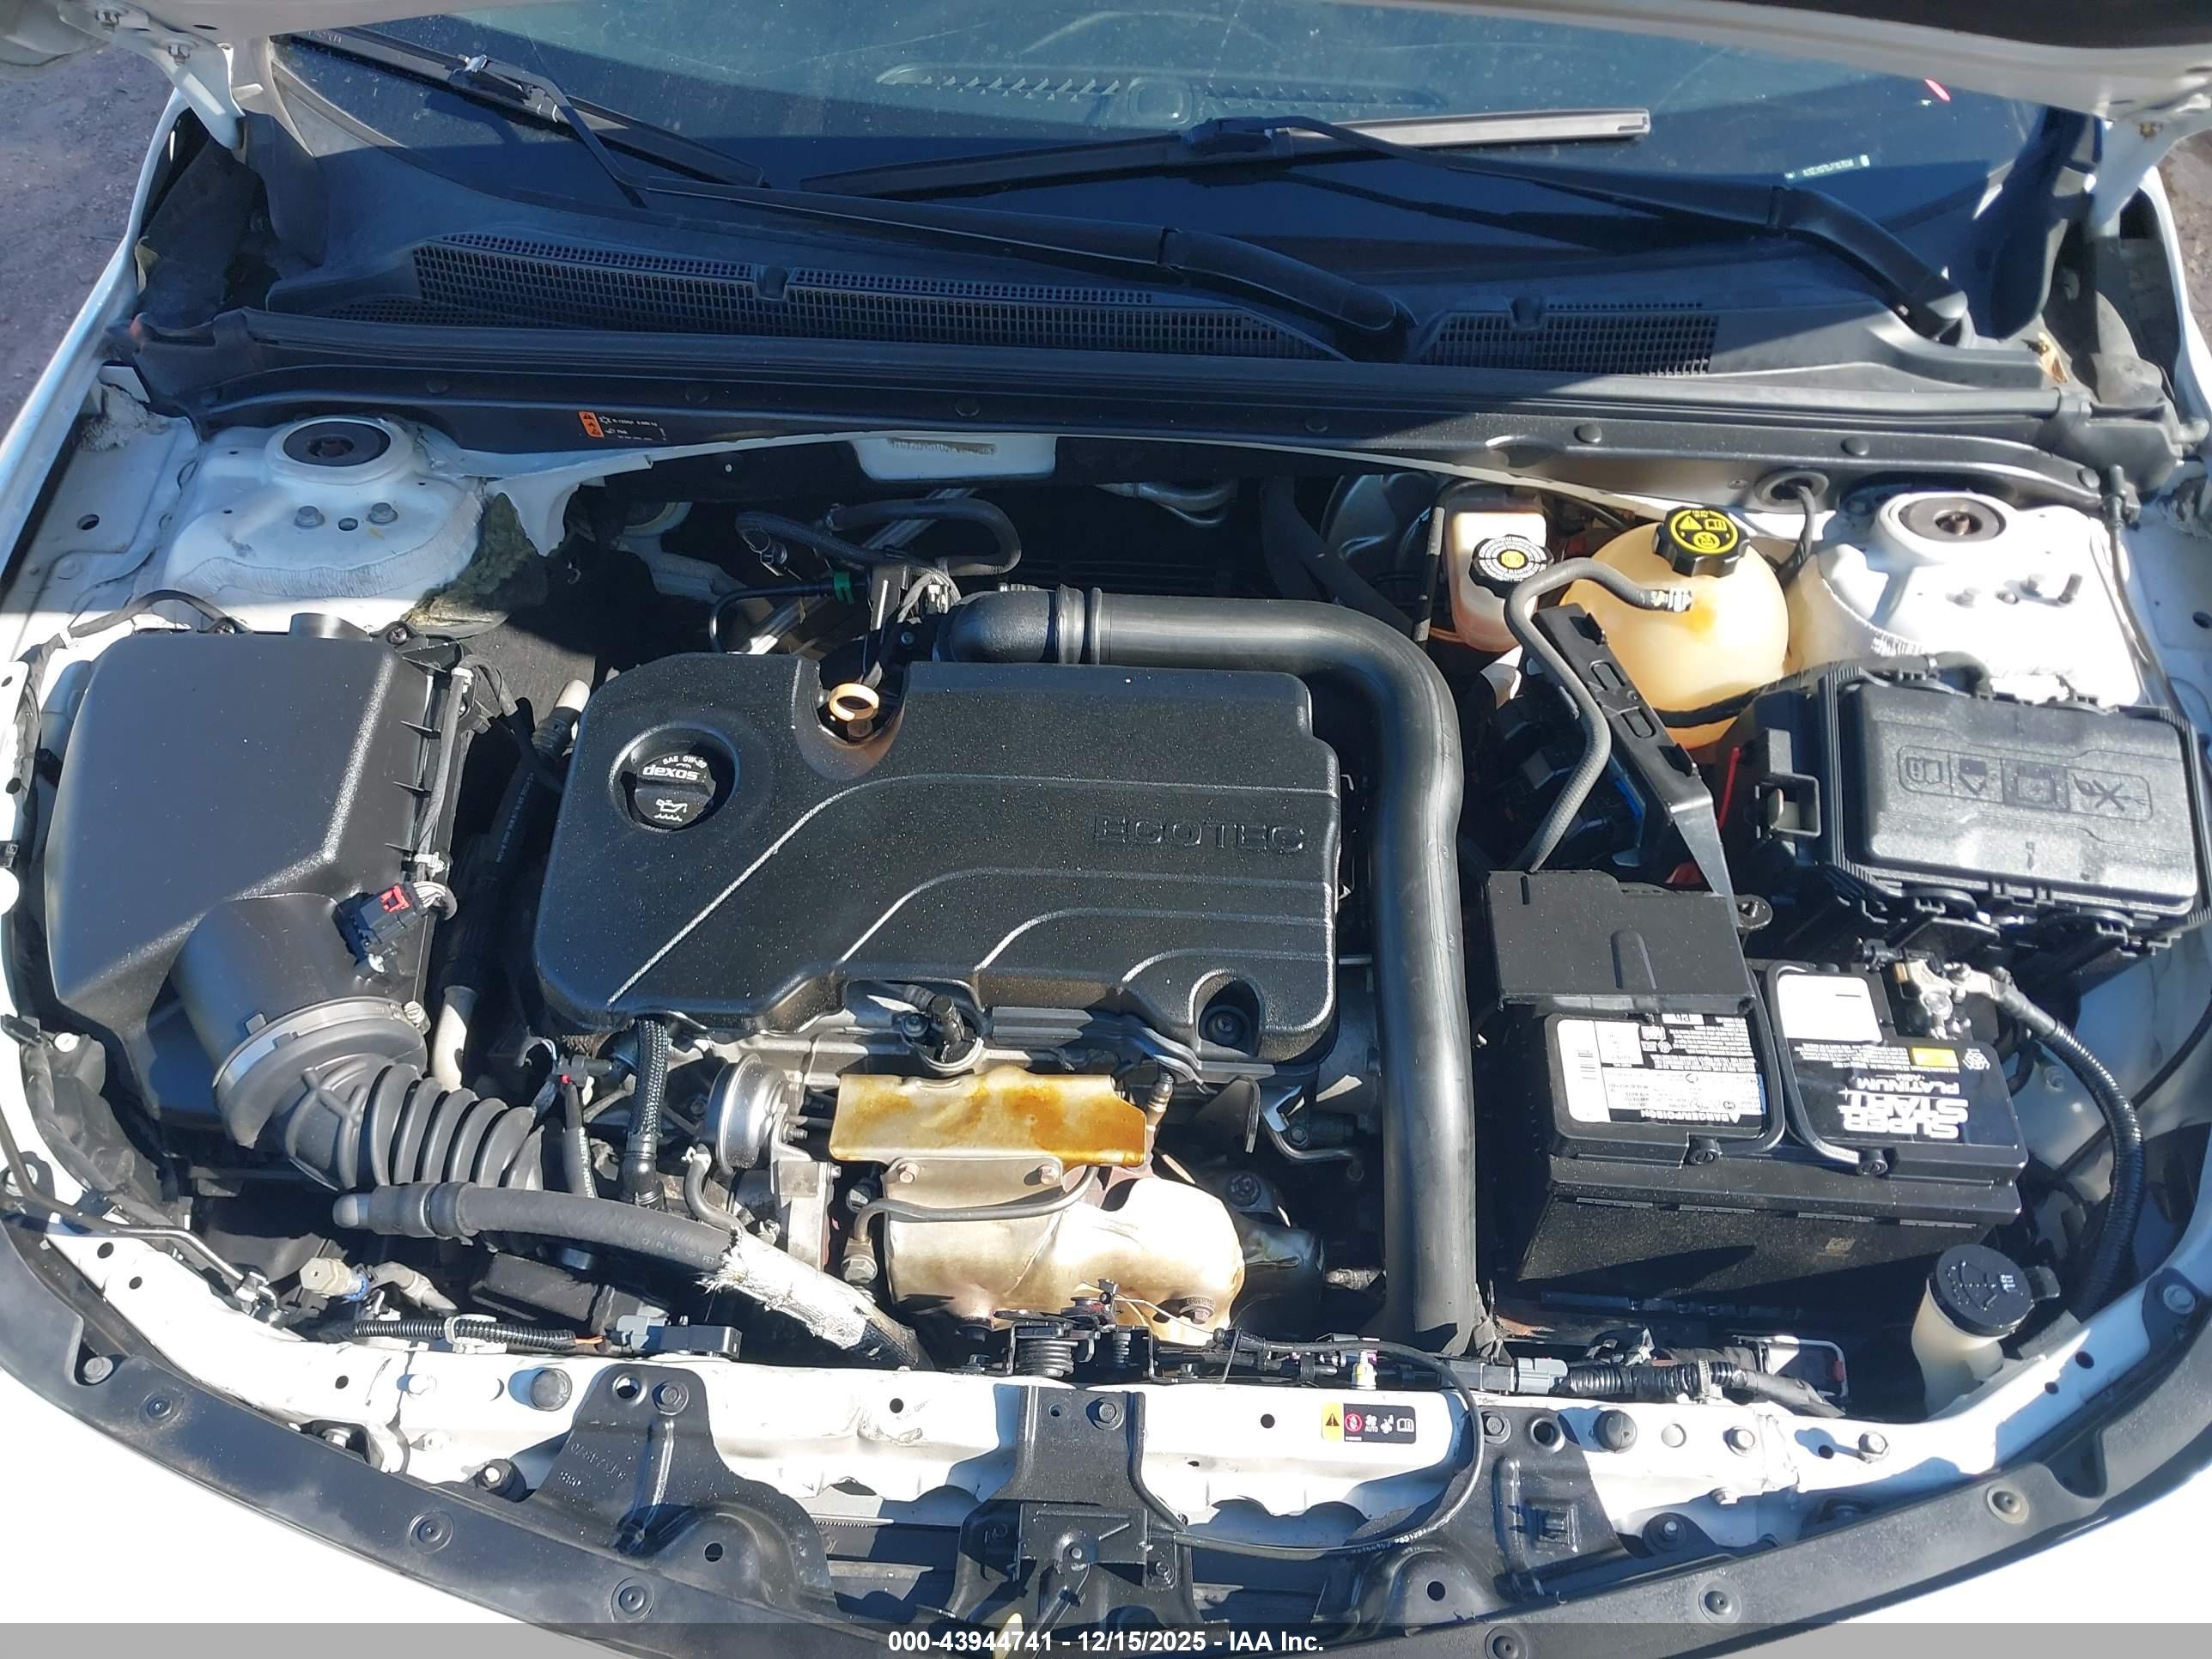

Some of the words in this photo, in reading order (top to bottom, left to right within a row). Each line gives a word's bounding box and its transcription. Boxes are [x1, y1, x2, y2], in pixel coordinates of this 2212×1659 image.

[662, 756, 678, 765] SAE
[683, 756, 708, 769] 0W-20
[642, 764, 701, 781] dexos
[1094, 815, 1305, 854] ECOTEC
[1856, 1078, 1960, 1095] PLATINUM
[1640, 1109, 1729, 1122] DANGER/POISON
[1839, 1091, 1968, 1123] START
[1843, 1111, 1959, 1139] SUPER
